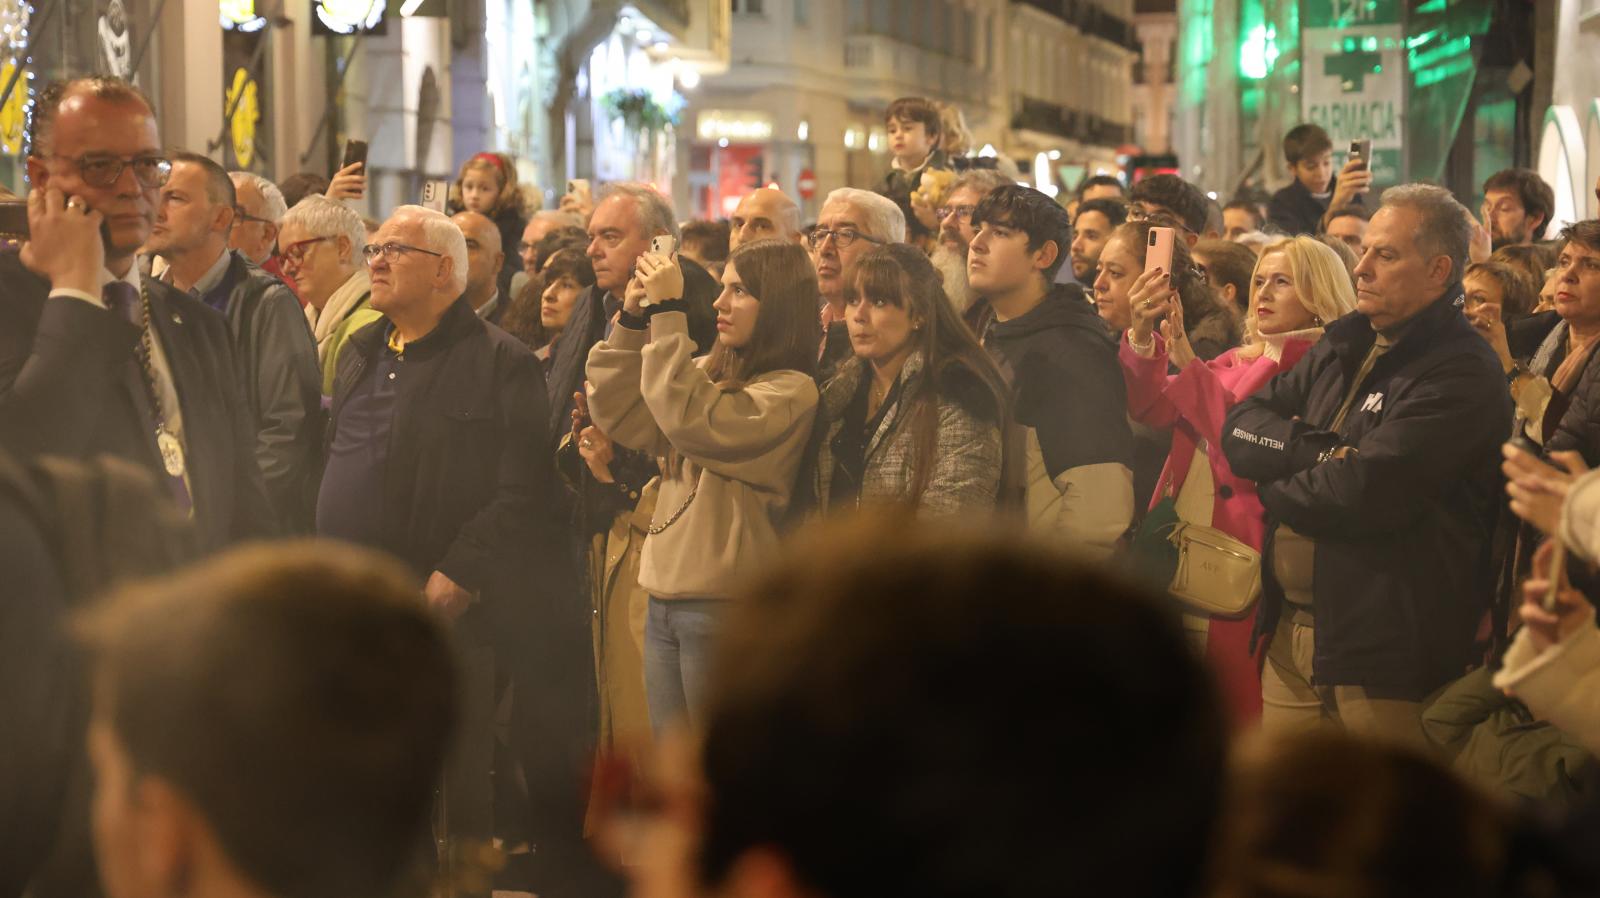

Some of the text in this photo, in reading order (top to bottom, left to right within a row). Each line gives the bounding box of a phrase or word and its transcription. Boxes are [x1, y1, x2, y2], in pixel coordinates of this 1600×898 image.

[1310, 101, 1396, 140] FARMACIA
[1232, 427, 1284, 451] HELLY HANSEN
